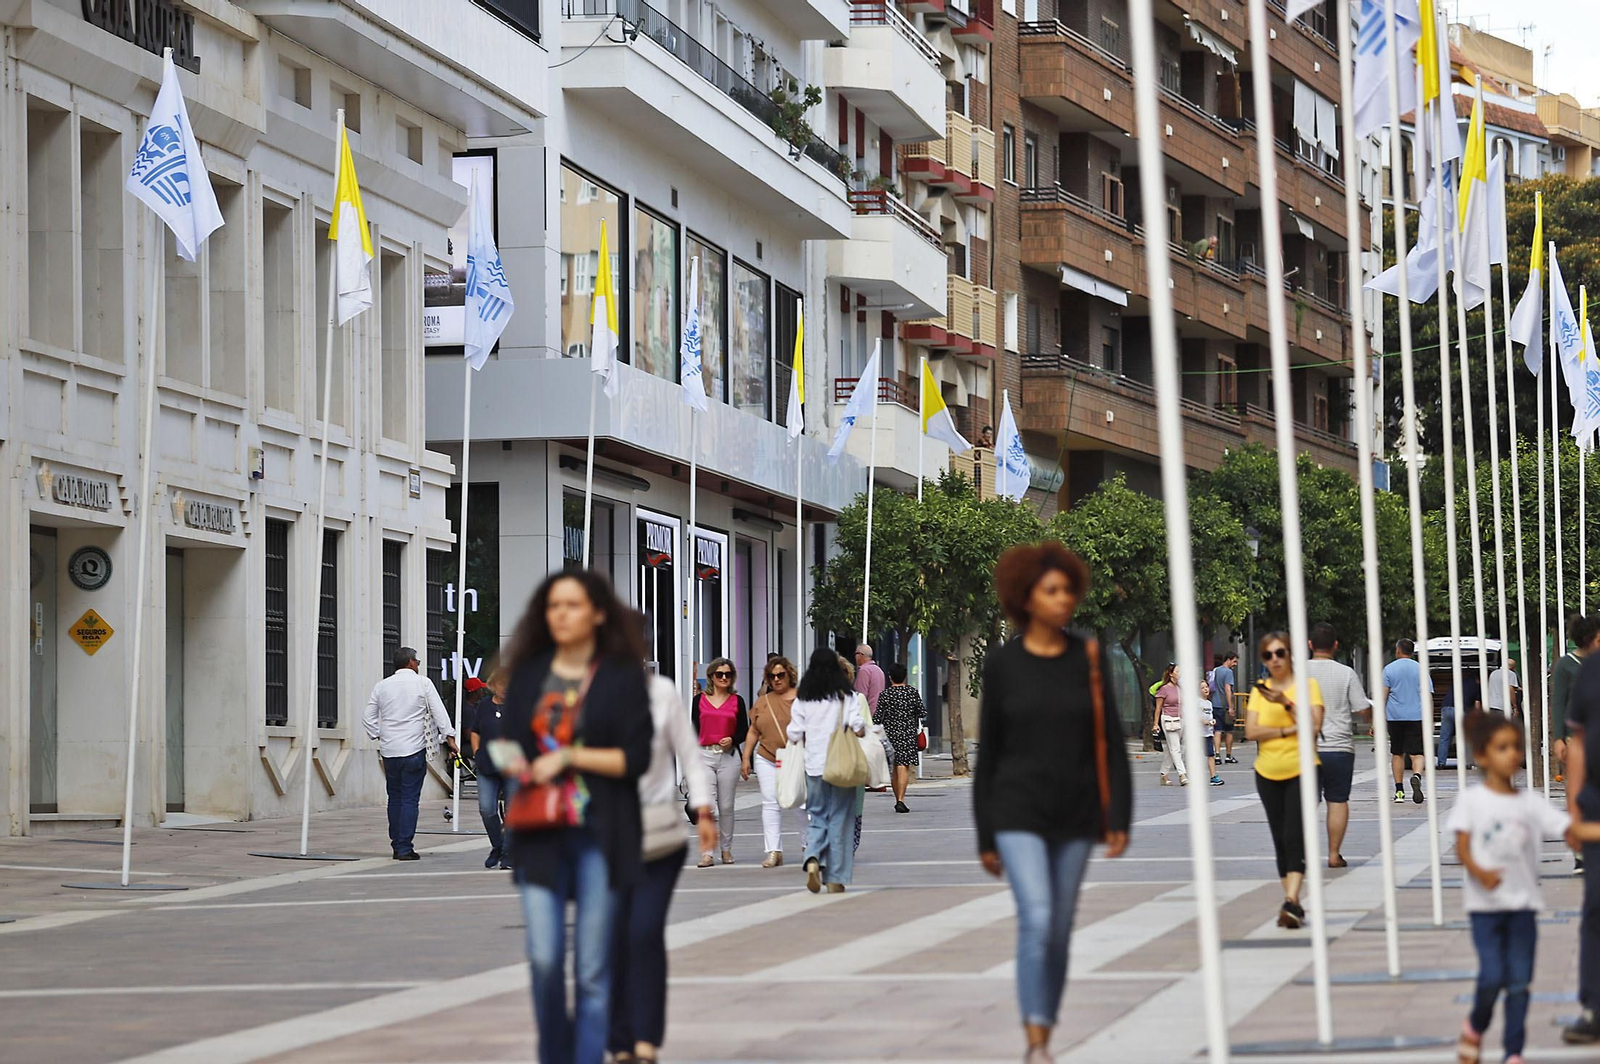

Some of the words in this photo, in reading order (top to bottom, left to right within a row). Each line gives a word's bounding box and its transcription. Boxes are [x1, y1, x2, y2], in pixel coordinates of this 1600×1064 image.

[135, 0, 200, 75] RURAL
[81, 477, 112, 512] RURAL
[209, 503, 236, 535] RURAL
[646, 522, 671, 554] PRIMOR
[697, 538, 719, 568] PRIMOR
[441, 583, 478, 612] th
[76, 628, 107, 636] SEGUROS
